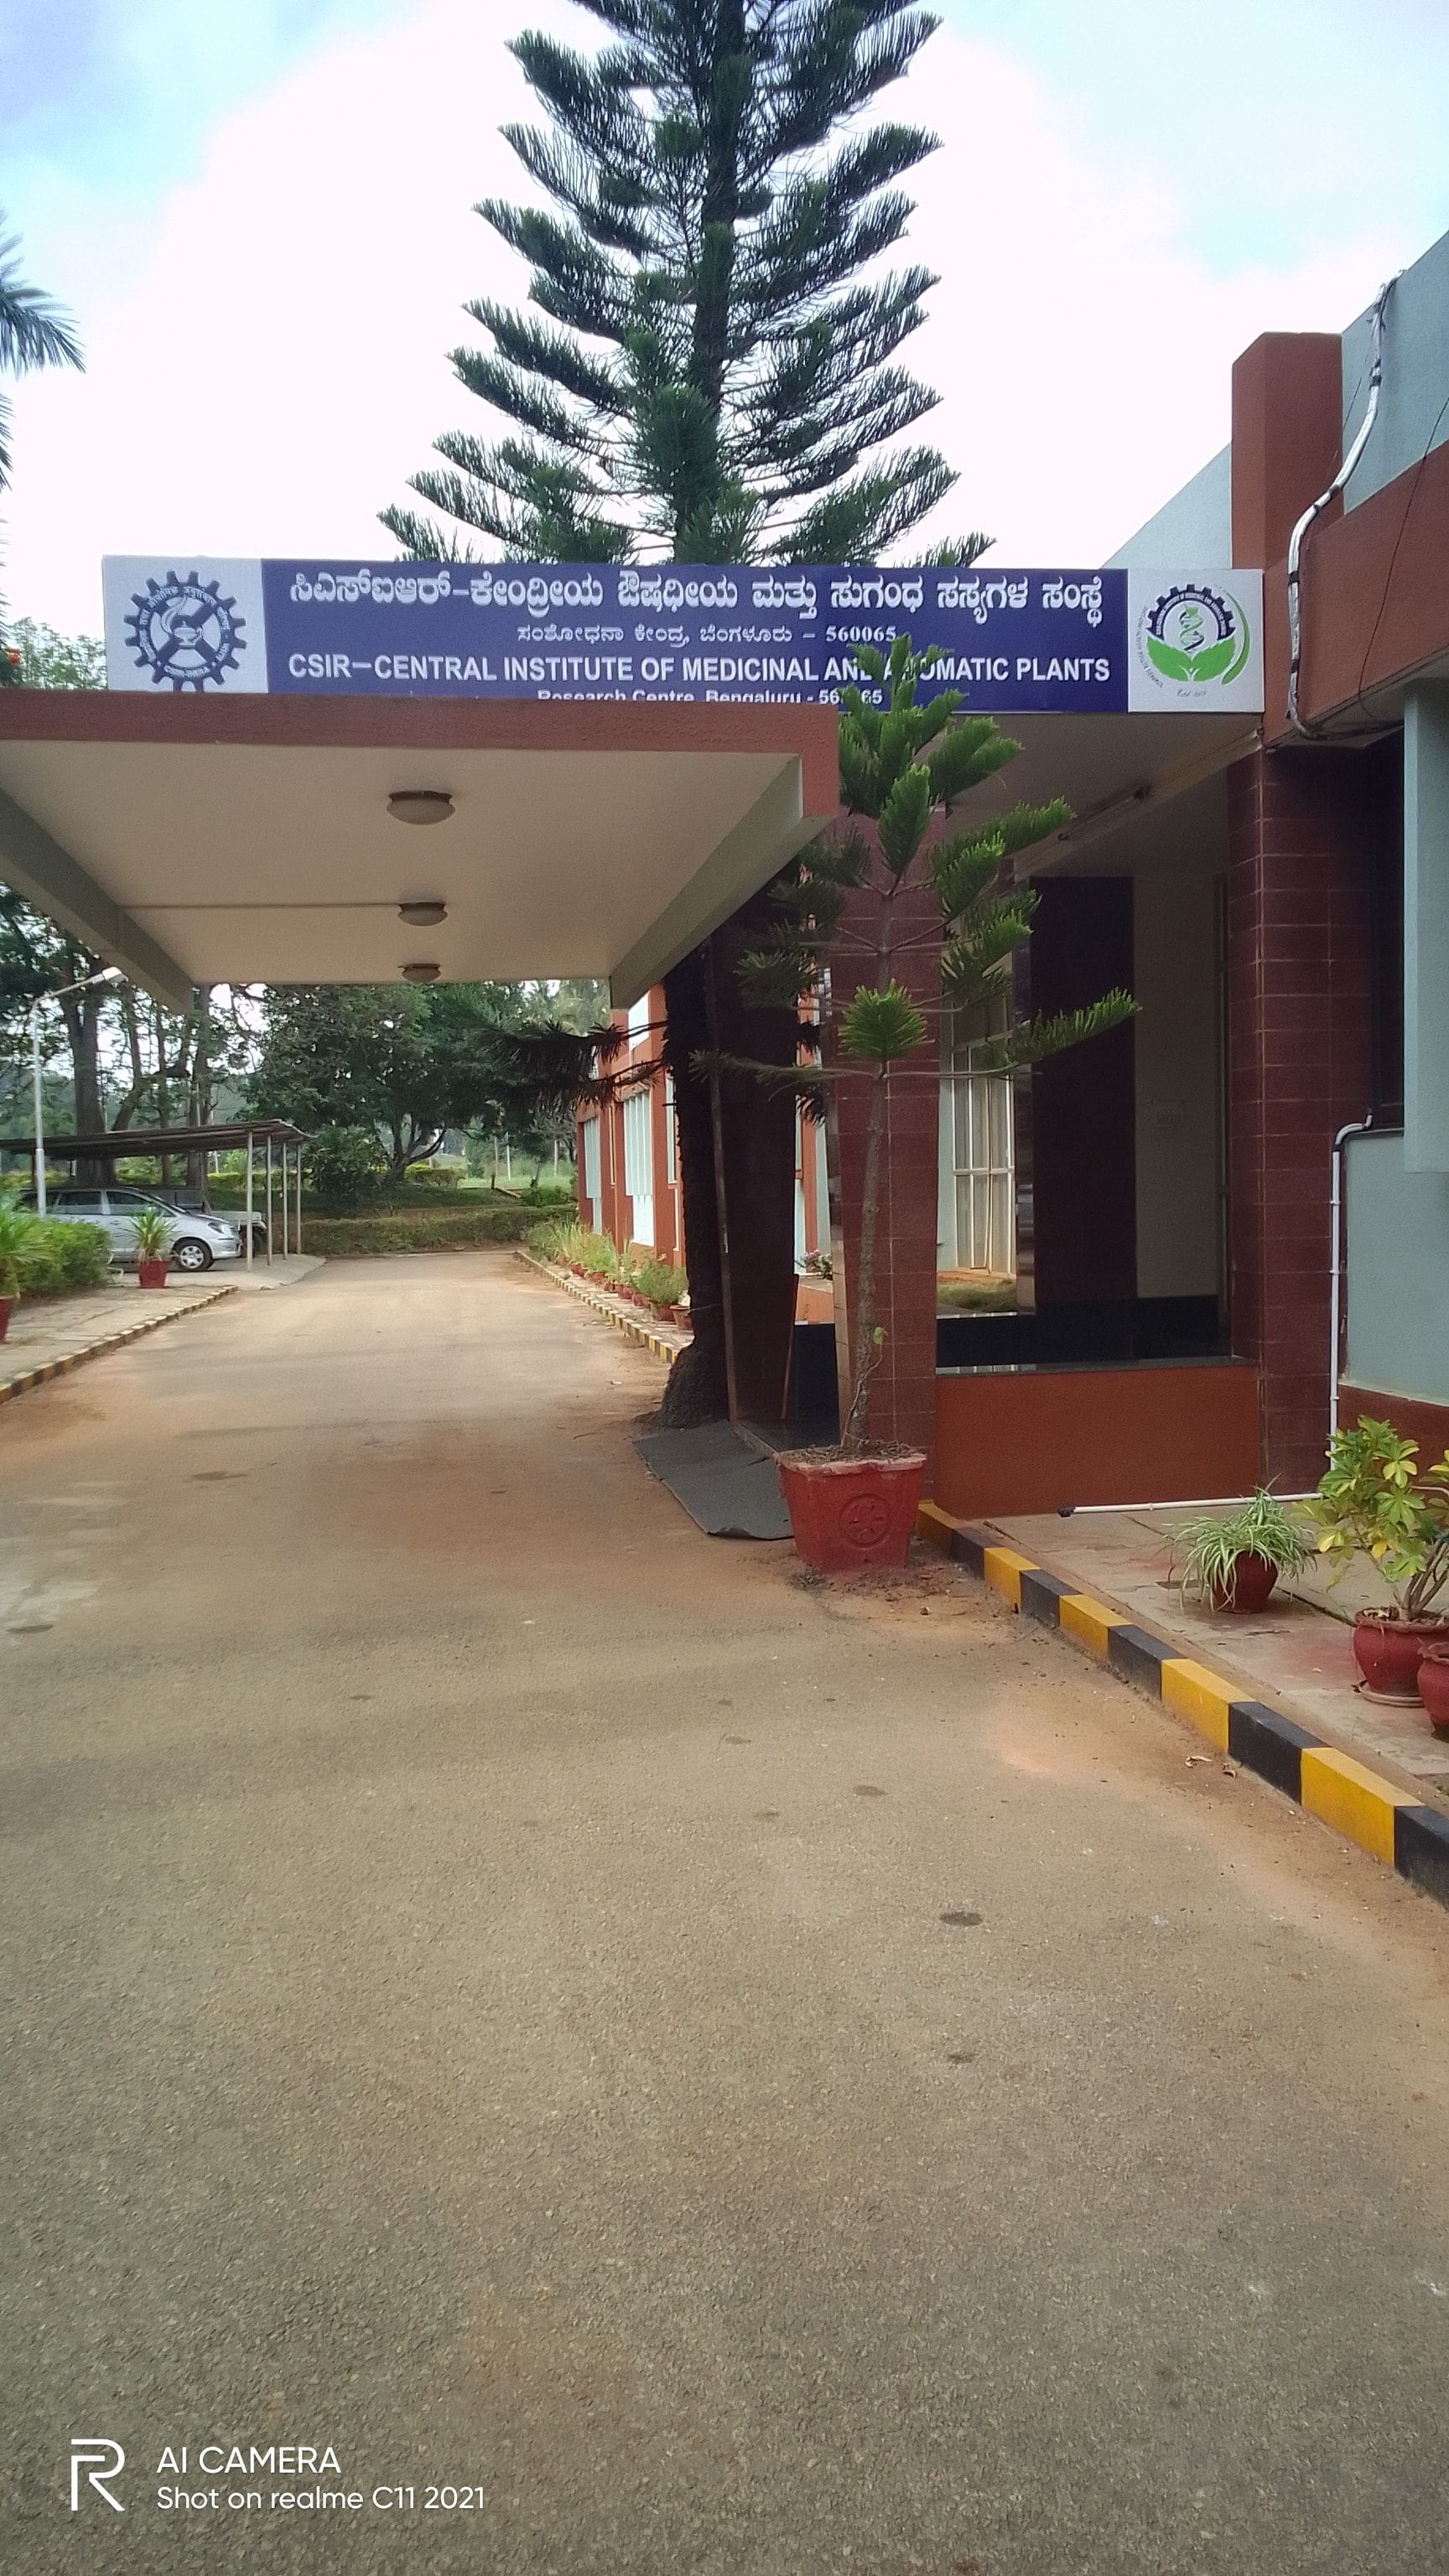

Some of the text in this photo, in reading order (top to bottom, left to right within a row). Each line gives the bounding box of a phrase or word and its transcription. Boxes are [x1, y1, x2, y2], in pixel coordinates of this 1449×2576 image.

[617, 570, 738, 613] ಔಷಧೀಯ
[751, 574, 818, 620] ಮತ್ತು
[830, 575, 923, 614] ಸುಗಂಧ
[937, 575, 1028, 625] ಸಸ್ಯಗಳ
[1041, 575, 1103, 628] ಸಂಸ್ಥೆ
[517, 623, 624, 645] ಸಂಶೋಧನಾ
[699, 624, 792, 643] ಬೆಂಗಳೂರು
[825, 625, 896, 643] 560065
[504, 657, 634, 682] INSTITUTE
[641, 657, 675, 682] OF
[682, 657, 819, 682] MEDICINAL
[1016, 657, 1111, 683] PLANTS
